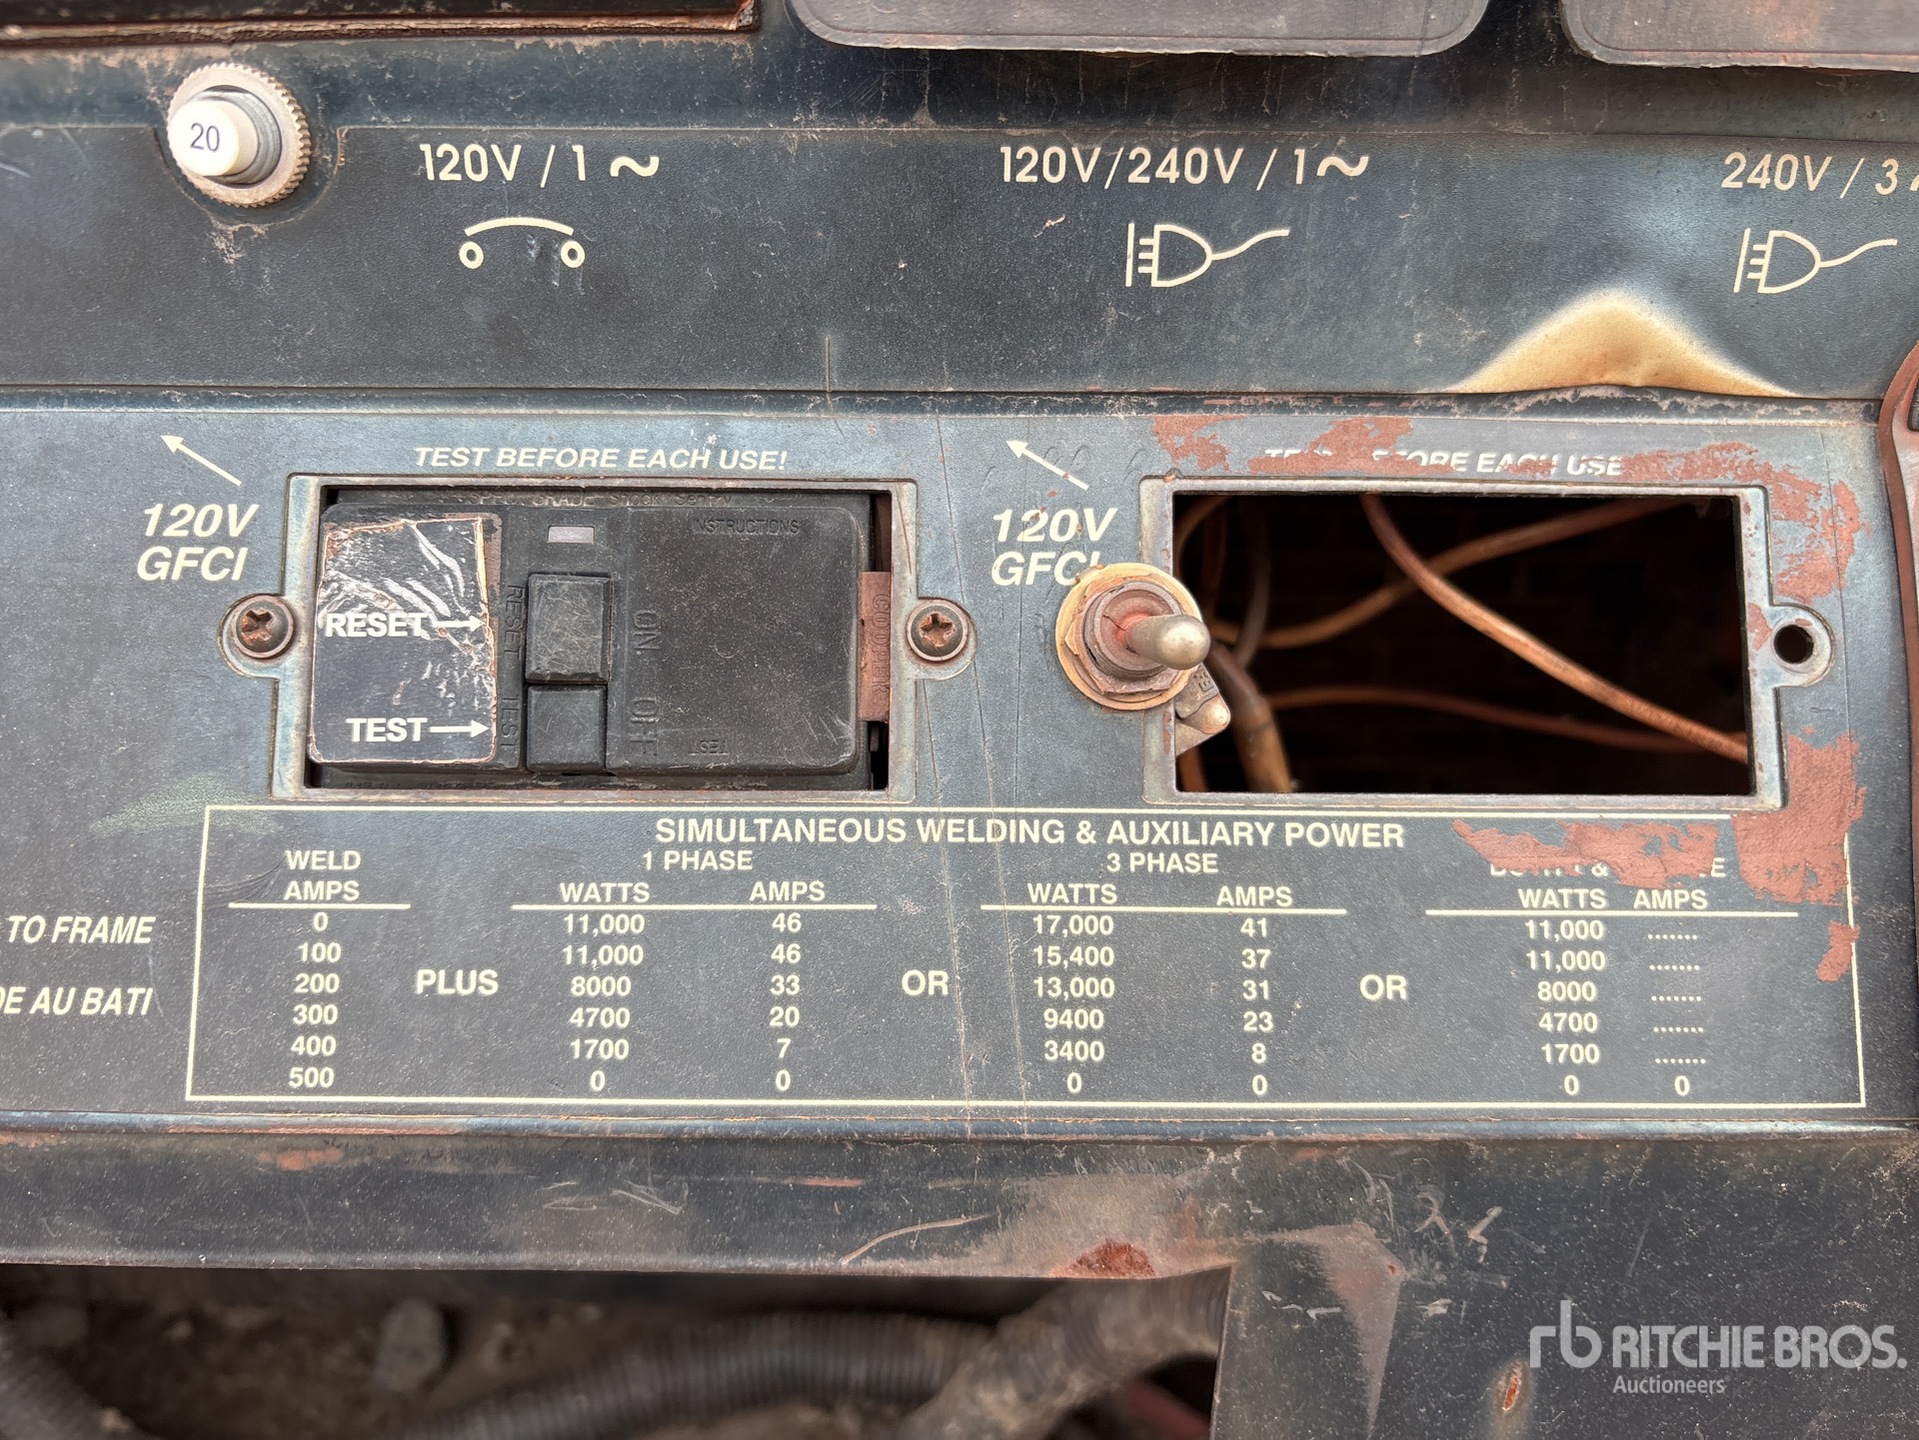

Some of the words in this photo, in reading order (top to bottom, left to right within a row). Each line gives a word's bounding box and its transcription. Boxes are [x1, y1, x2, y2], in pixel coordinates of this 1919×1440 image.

[189, 122, 220, 153] 20
[419, 143, 521, 181] 120V
[1721, 151, 1833, 192] 240V
[415, 447, 489, 467] TEST
[496, 447, 619, 469] BEFORE
[627, 449, 709, 470] EACH
[718, 450, 788, 470] USE!
[1370, 451, 1470, 472] ORE
[143, 504, 260, 537] 120V
[691, 518, 801, 534] INSTRUCTIONS
[992, 507, 1119, 543] 120V
[137, 547, 248, 582] GFCI
[324, 612, 426, 638] RESET
[507, 583, 526, 661] RESET
[871, 594, 890, 694] COOPER
[346, 717, 428, 742] TEST
[501, 696, 520, 752] TEST
[655, 818, 907, 844] SIMULTANEOUS
[917, 819, 1066, 846] WELDING
[1076, 822, 1098, 845] &
[1106, 821, 1276, 847] AUXILIARY
[1285, 822, 1405, 849] POWER
[285, 850, 362, 871] WELD
[642, 853, 653, 871] 1
[663, 851, 753, 872] PHASE
[1106, 854, 1122, 873] 3
[1129, 854, 1219, 874] PHASE
[284, 881, 361, 902] AMPS
[559, 883, 651, 903] WATTS
[749, 882, 827, 902] AMPS
[1027, 883, 1119, 905] WATTS
[1216, 887, 1294, 908] AMPS
[1517, 888, 1608, 910] WATTS
[1633, 890, 1709, 910] AMPS
[8, 915, 47, 944] TO
[51, 915, 157, 945] FRAME
[312, 911, 329, 932] 0
[564, 913, 646, 937] 11,000
[772, 912, 803, 933] 46
[1033, 915, 1114, 939] 17,000
[1240, 917, 1268, 938] 41
[1525, 919, 1605, 943] 11,000
[299, 942, 342, 963] 100
[563, 944, 645, 969] 11,000
[771, 943, 802, 964] 46
[1033, 946, 1115, 970] 15,400
[1241, 948, 1271, 970] 37
[1526, 950, 1606, 974] 11,000
[295, 973, 340, 994] 200
[416, 969, 499, 995] PLUS
[571, 975, 632, 997] 8000
[770, 974, 801, 996] 33
[902, 969, 949, 996] OR
[1034, 977, 1115, 1001] 13,000
[1242, 979, 1270, 1000] 31
[1360, 974, 1408, 1001] OR
[1537, 980, 1597, 1002] 8000
[29, 986, 76, 1015] AU
[80, 987, 153, 1015] BATI
[293, 1004, 338, 1025] 300
[570, 1006, 631, 1028] 4700
[770, 1005, 800, 1027] 20
[1043, 1009, 1104, 1030] 9400
[1243, 1011, 1274, 1032] 23
[1539, 1012, 1598, 1034] 4700
[291, 1035, 337, 1057] 400
[570, 1038, 630, 1060] 1700
[777, 1038, 792, 1058] 7
[1044, 1040, 1105, 1062] 3400
[1251, 1043, 1267, 1064] 8
[1541, 1044, 1600, 1065] 1700
[288, 1067, 335, 1089] 500
[590, 1070, 606, 1092] 0
[775, 1070, 791, 1092] 0
[1067, 1072, 1082, 1094] 0
[1251, 1074, 1268, 1096] 0
[1563, 1074, 1580, 1096] 0
[1674, 1074, 1690, 1096] 0
